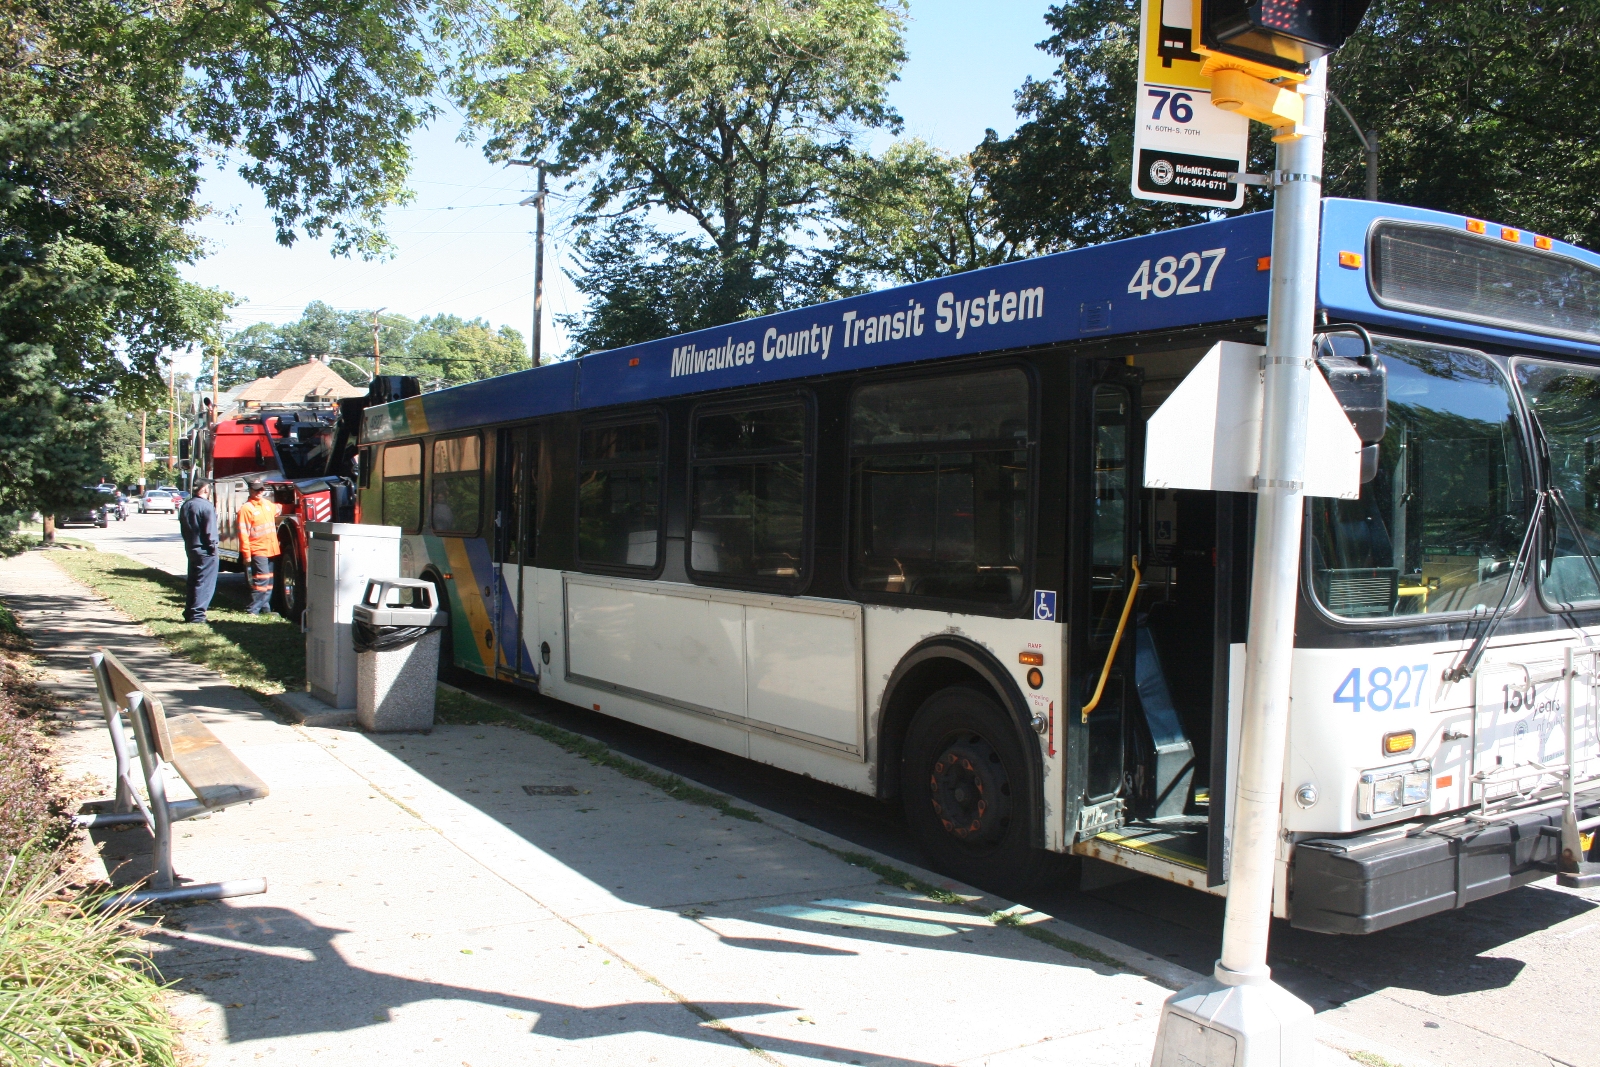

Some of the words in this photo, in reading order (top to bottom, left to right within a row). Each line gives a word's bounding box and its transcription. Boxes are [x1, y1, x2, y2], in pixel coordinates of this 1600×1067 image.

[1148, 89, 1194, 123] 76
[1184, 128, 1201, 136] 70TH
[1175, 176, 1227, 190] 414-344-6711
[1176, 164, 1228, 178] RideMCTS.com
[1127, 247, 1226, 301] 4827
[670, 340, 755, 379] Milwaukee
[762, 324, 834, 362] County
[842, 302, 925, 348] Transit
[934, 286, 1045, 340] System
[1333, 663, 1429, 713] 4827
[1502, 684, 1536, 714] 150
[1532, 699, 1560, 721] years
